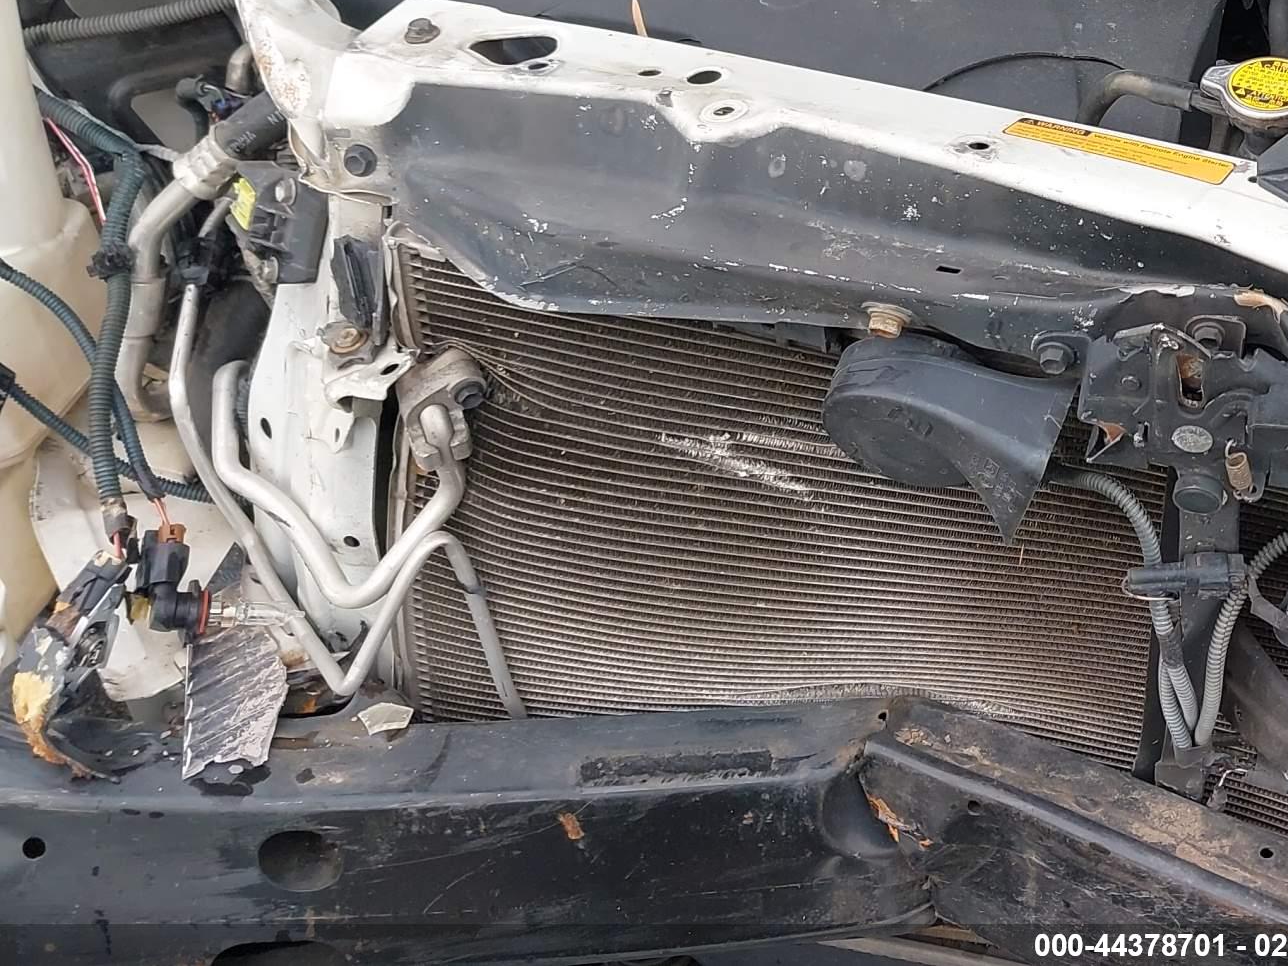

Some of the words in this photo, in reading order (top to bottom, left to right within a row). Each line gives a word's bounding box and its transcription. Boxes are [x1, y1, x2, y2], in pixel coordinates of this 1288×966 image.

[1036, 120, 1086, 136] WARNING
[1094, 133, 1121, 144] Vehicle
[1123, 139, 1140, 148] with
[1141, 143, 1172, 154] Remote
[1173, 150, 1201, 161] Engine
[1202, 158, 1229, 168] Starter
